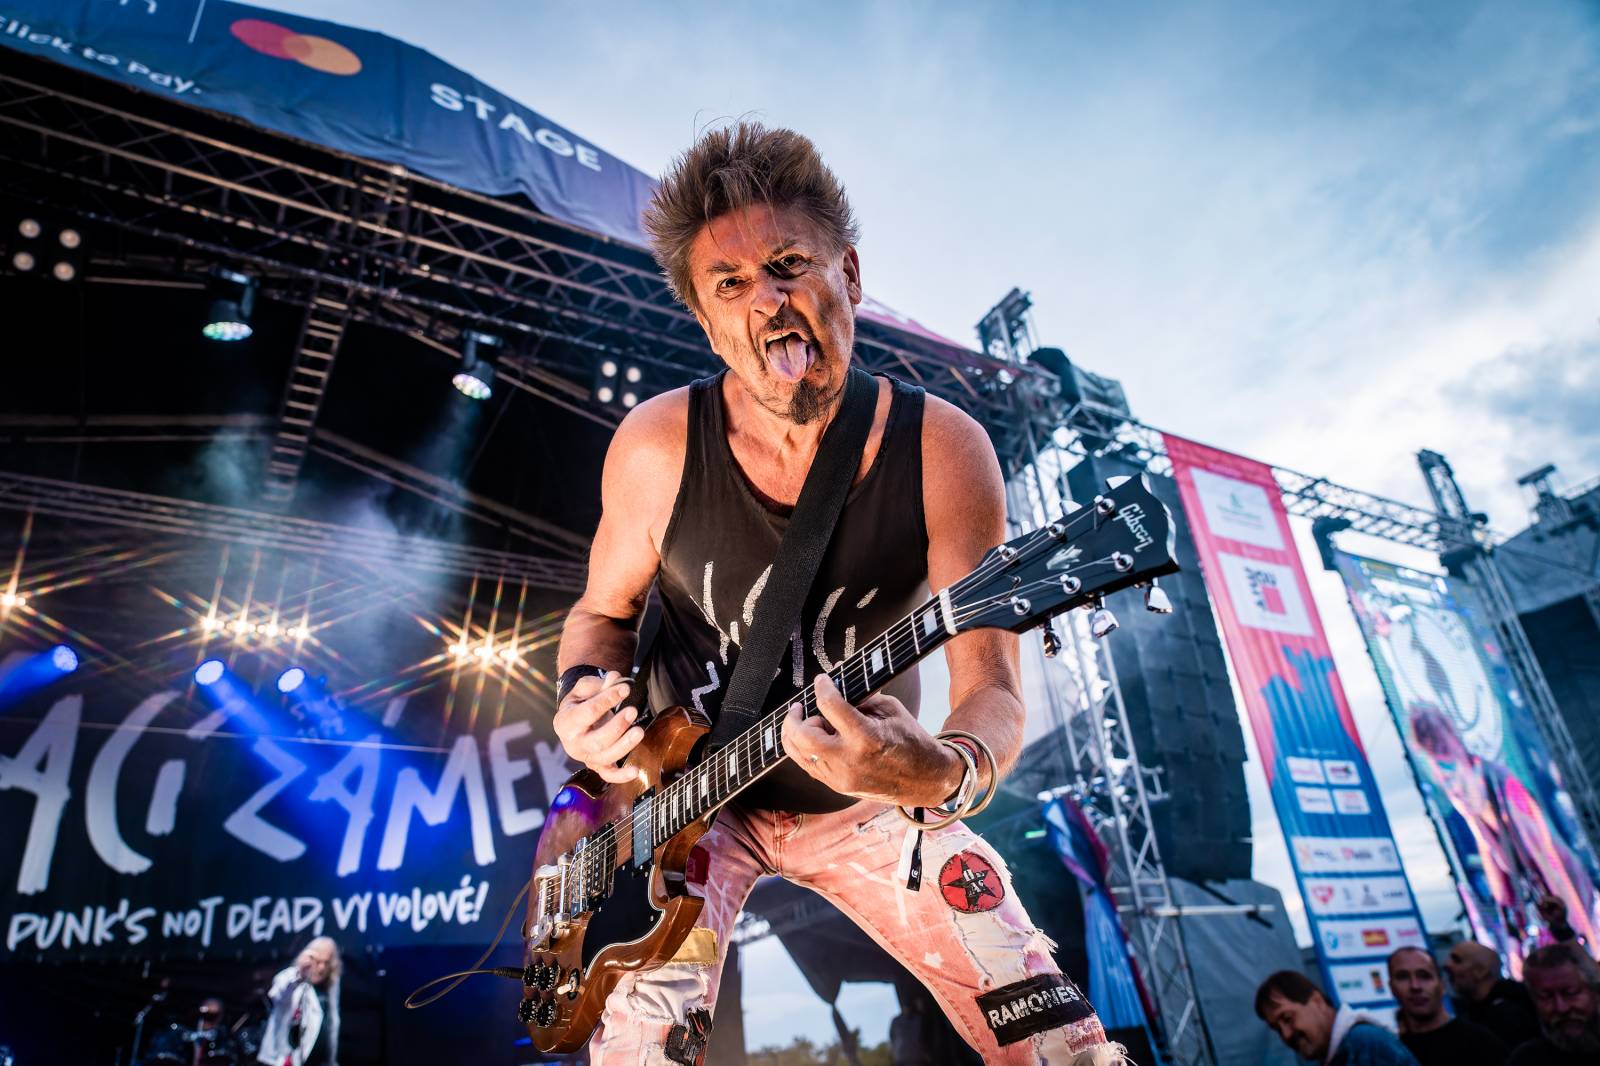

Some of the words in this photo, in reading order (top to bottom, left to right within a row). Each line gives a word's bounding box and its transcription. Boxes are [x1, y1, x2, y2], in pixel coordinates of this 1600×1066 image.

[83, 47, 120, 65] to
[127, 61, 202, 93] Pay.
[430, 83, 602, 172] STAGE
[1112, 502, 1154, 553] Gibson
[7, 898, 157, 951] PUNK'S
[226, 897, 326, 943] DEAD,
[332, 891, 373, 933] VY
[377, 874, 489, 933] VOLOVÉ!
[987, 986, 1080, 1029] RAMONES
